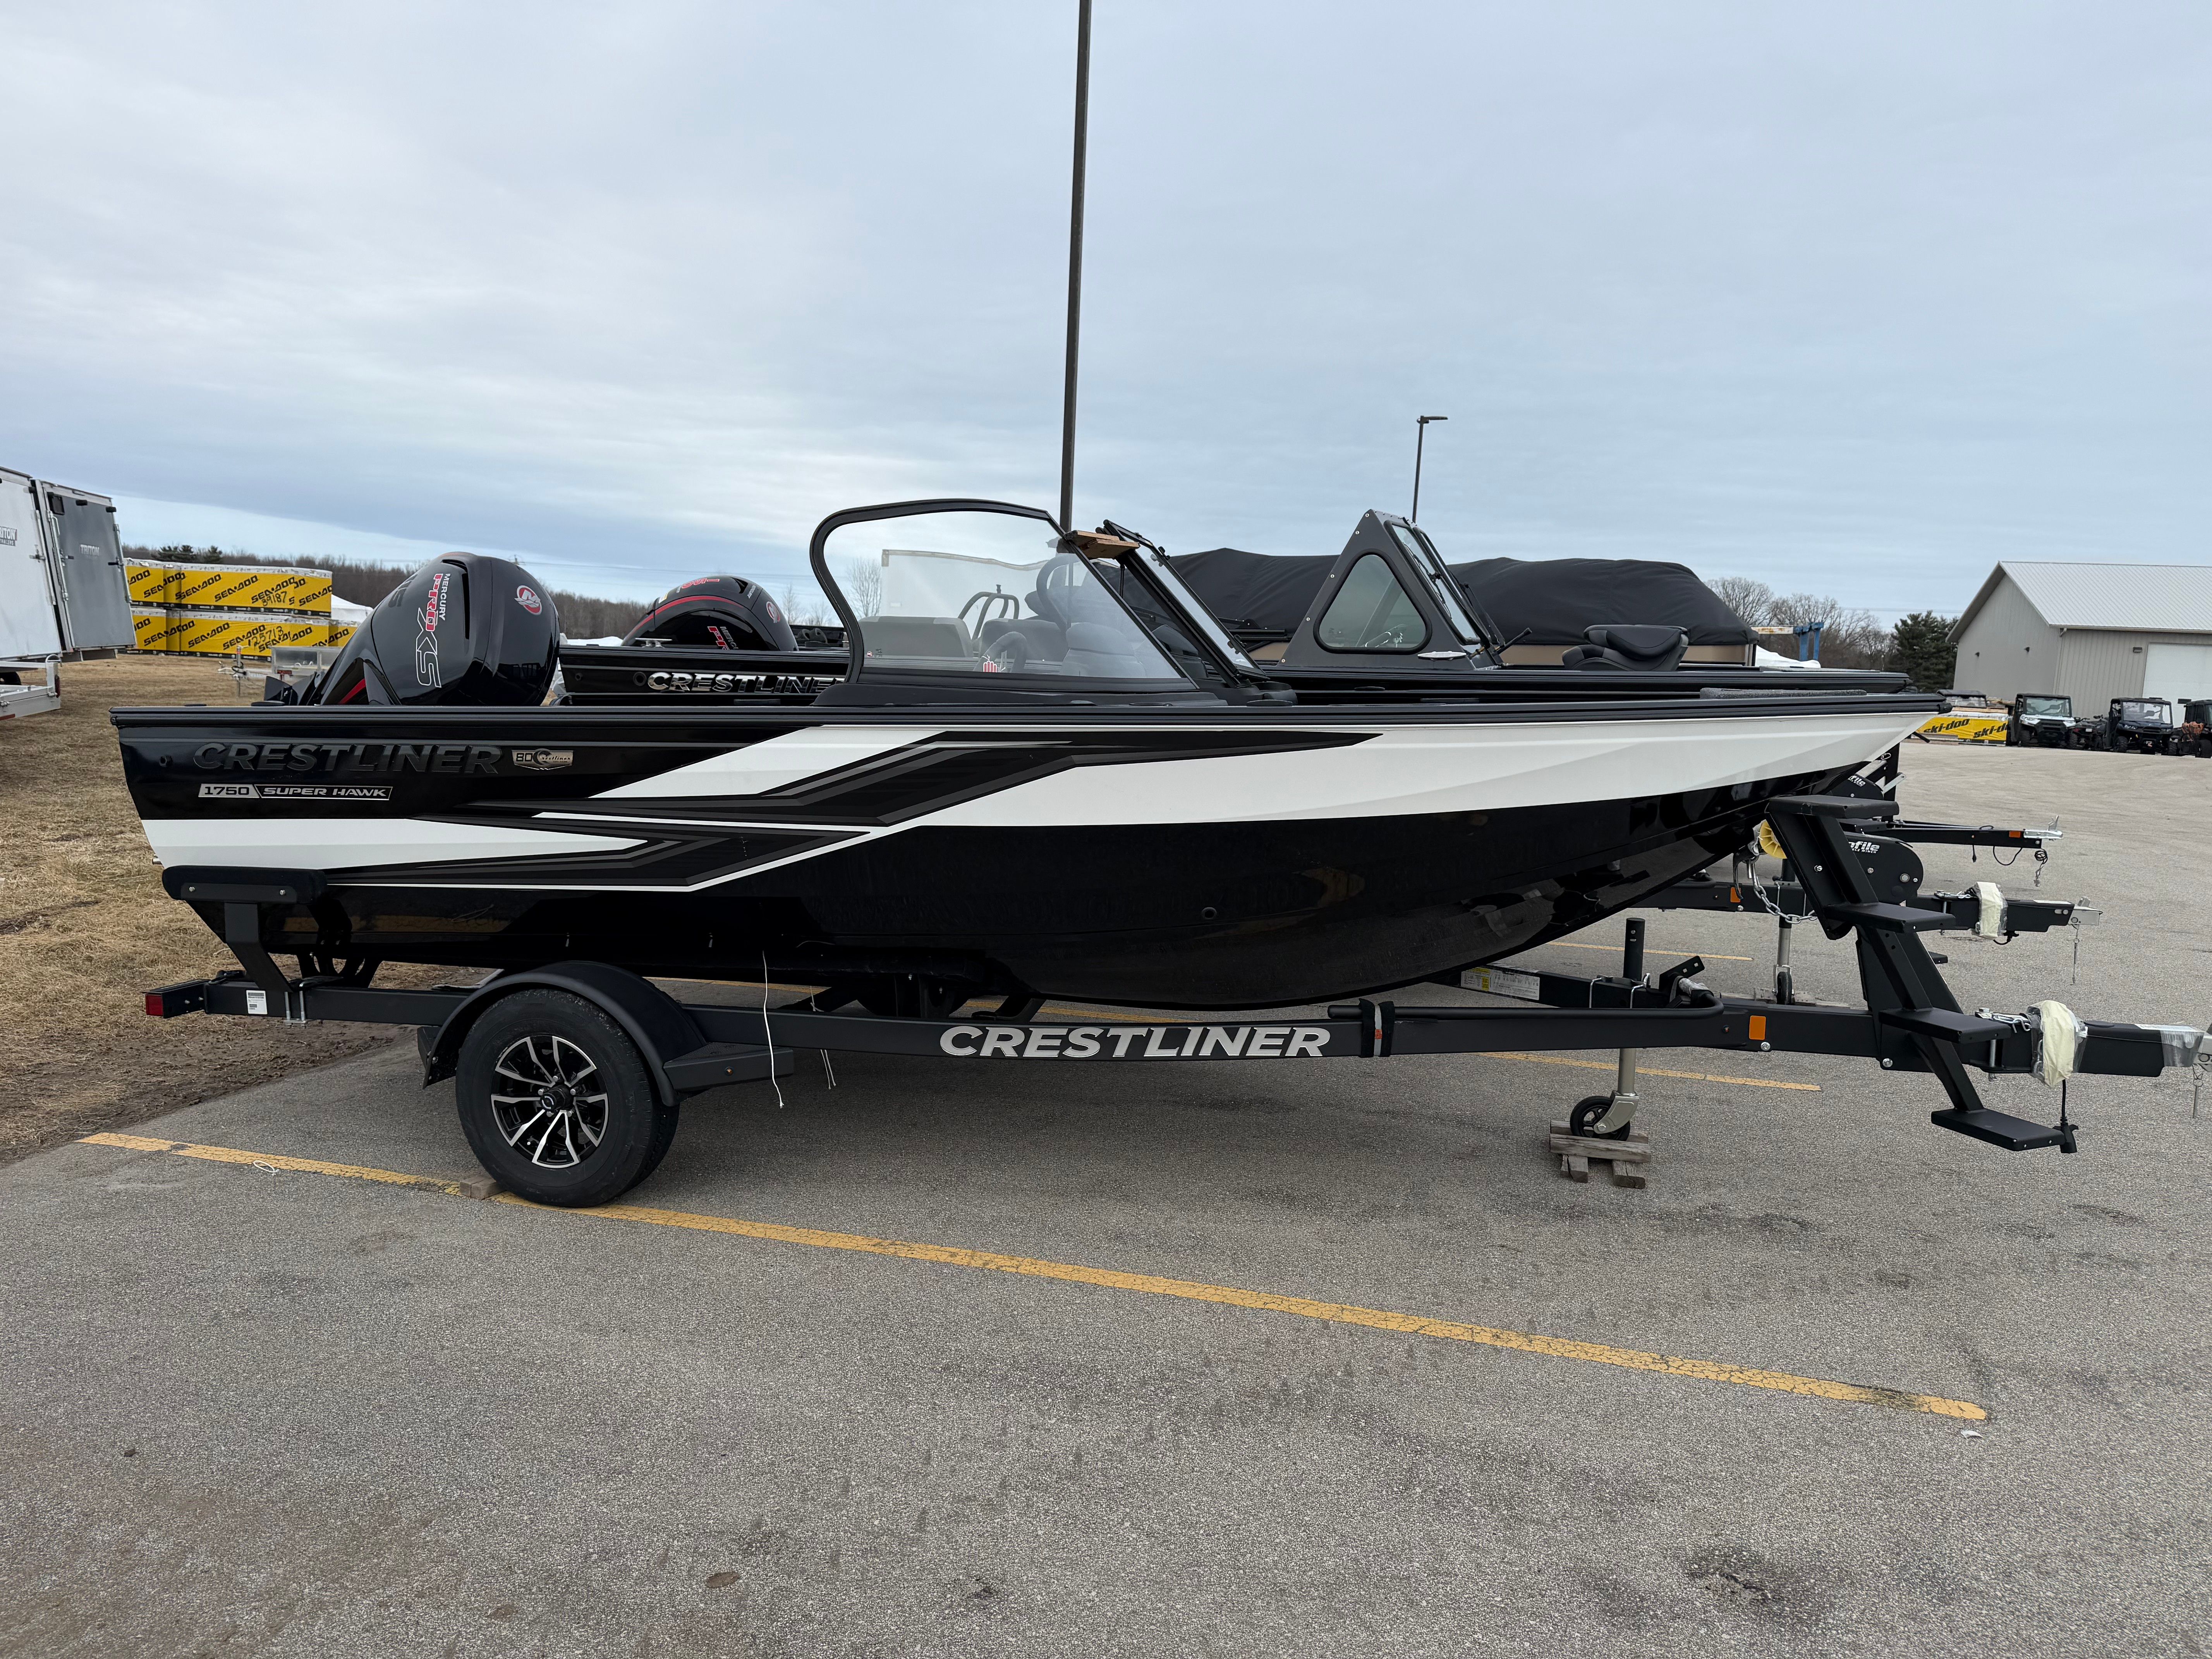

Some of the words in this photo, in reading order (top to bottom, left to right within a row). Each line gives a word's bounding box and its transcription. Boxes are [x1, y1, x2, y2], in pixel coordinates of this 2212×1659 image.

[425, 573, 443, 632] PRO
[439, 573, 451, 621] MERCURY
[416, 607, 442, 688] XS
[647, 672, 845, 693] CRESTLINE
[193, 742, 503, 774] CRESTLINER
[204, 786, 250, 795] 1750
[263, 787, 327, 795] SUPER
[332, 788, 386, 797] HAWK
[939, 1025, 1331, 1058] CRESTLINER
